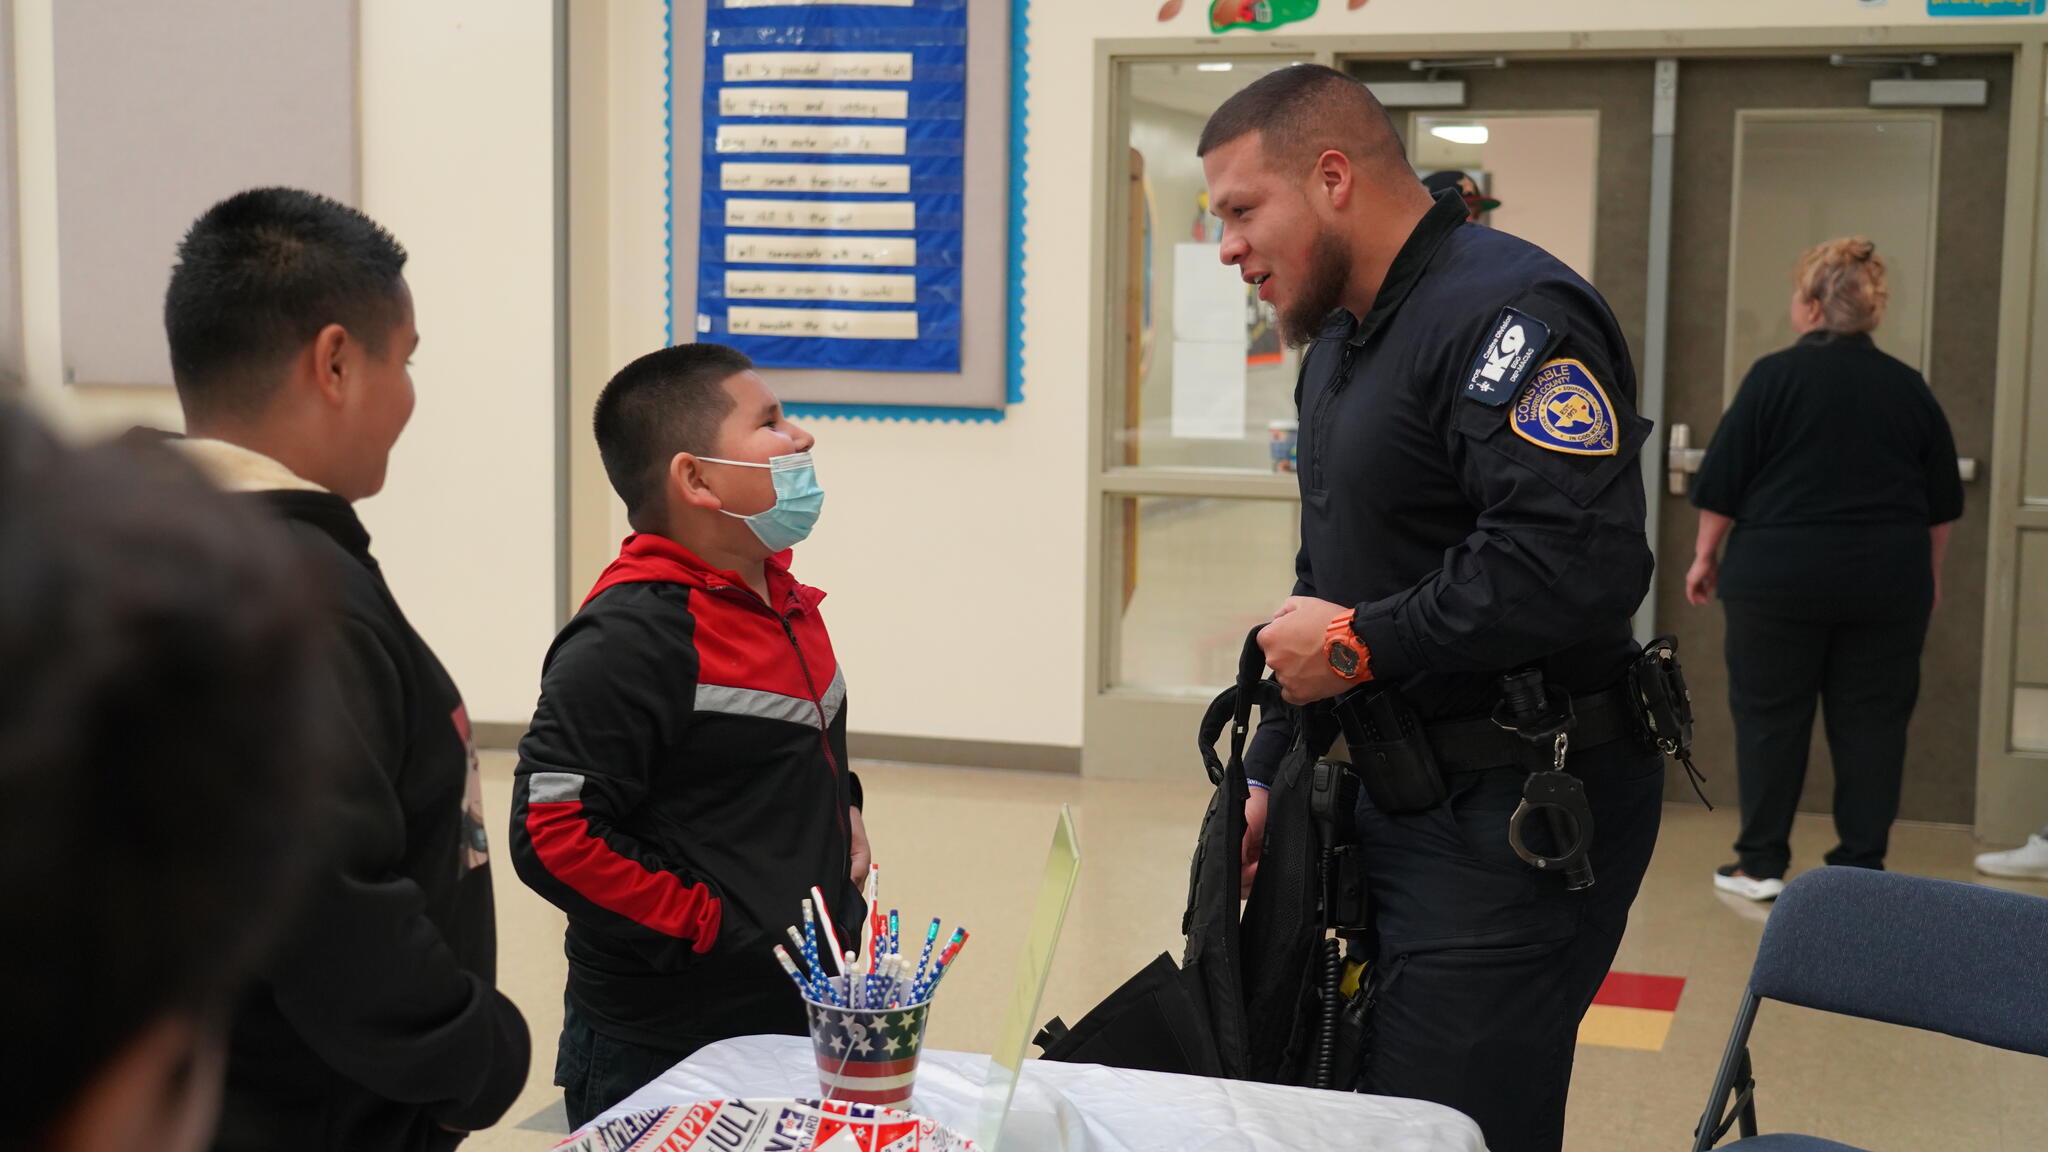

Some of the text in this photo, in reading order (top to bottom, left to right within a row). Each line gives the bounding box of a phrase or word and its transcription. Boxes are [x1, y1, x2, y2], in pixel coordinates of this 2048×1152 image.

[1480, 325, 1526, 383] K9
[1483, 315, 1513, 359] Canine Division
[1471, 368, 1481, 383] POS
[1517, 364, 1571, 423] CONSTABLE
[1530, 375, 1570, 421] HARRIS COUNTY
[1601, 437, 1612, 449] 6
